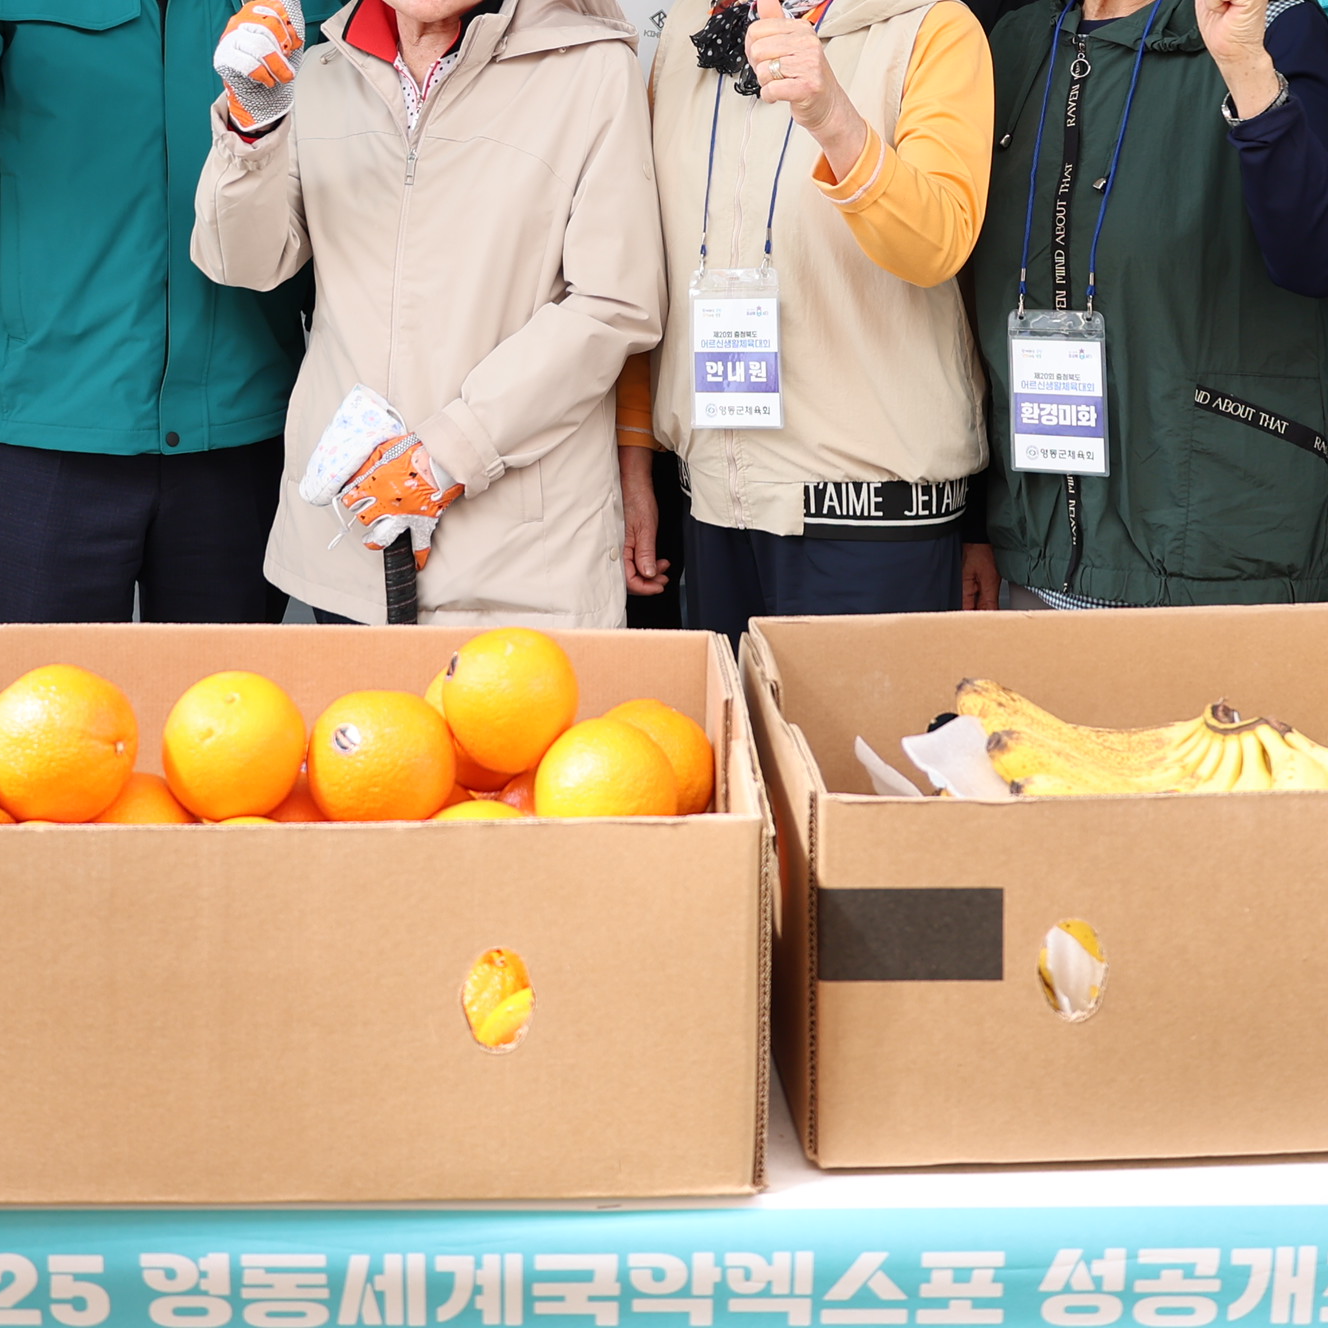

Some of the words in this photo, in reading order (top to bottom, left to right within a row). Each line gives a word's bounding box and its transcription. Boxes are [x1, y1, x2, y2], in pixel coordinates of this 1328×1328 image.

[1066, 83, 1080, 127] RAVEN
[1058, 162, 1073, 193] THAT
[1055, 199, 1067, 245] ABOUT
[705, 361, 767, 383] 안내원
[1020, 402, 1098, 427] 환경미화
[1212, 397, 1256, 421] ABOUT
[1258, 412, 1289, 434] THAT
[138, 1248, 1006, 1328] 영동세계국악엑스포
